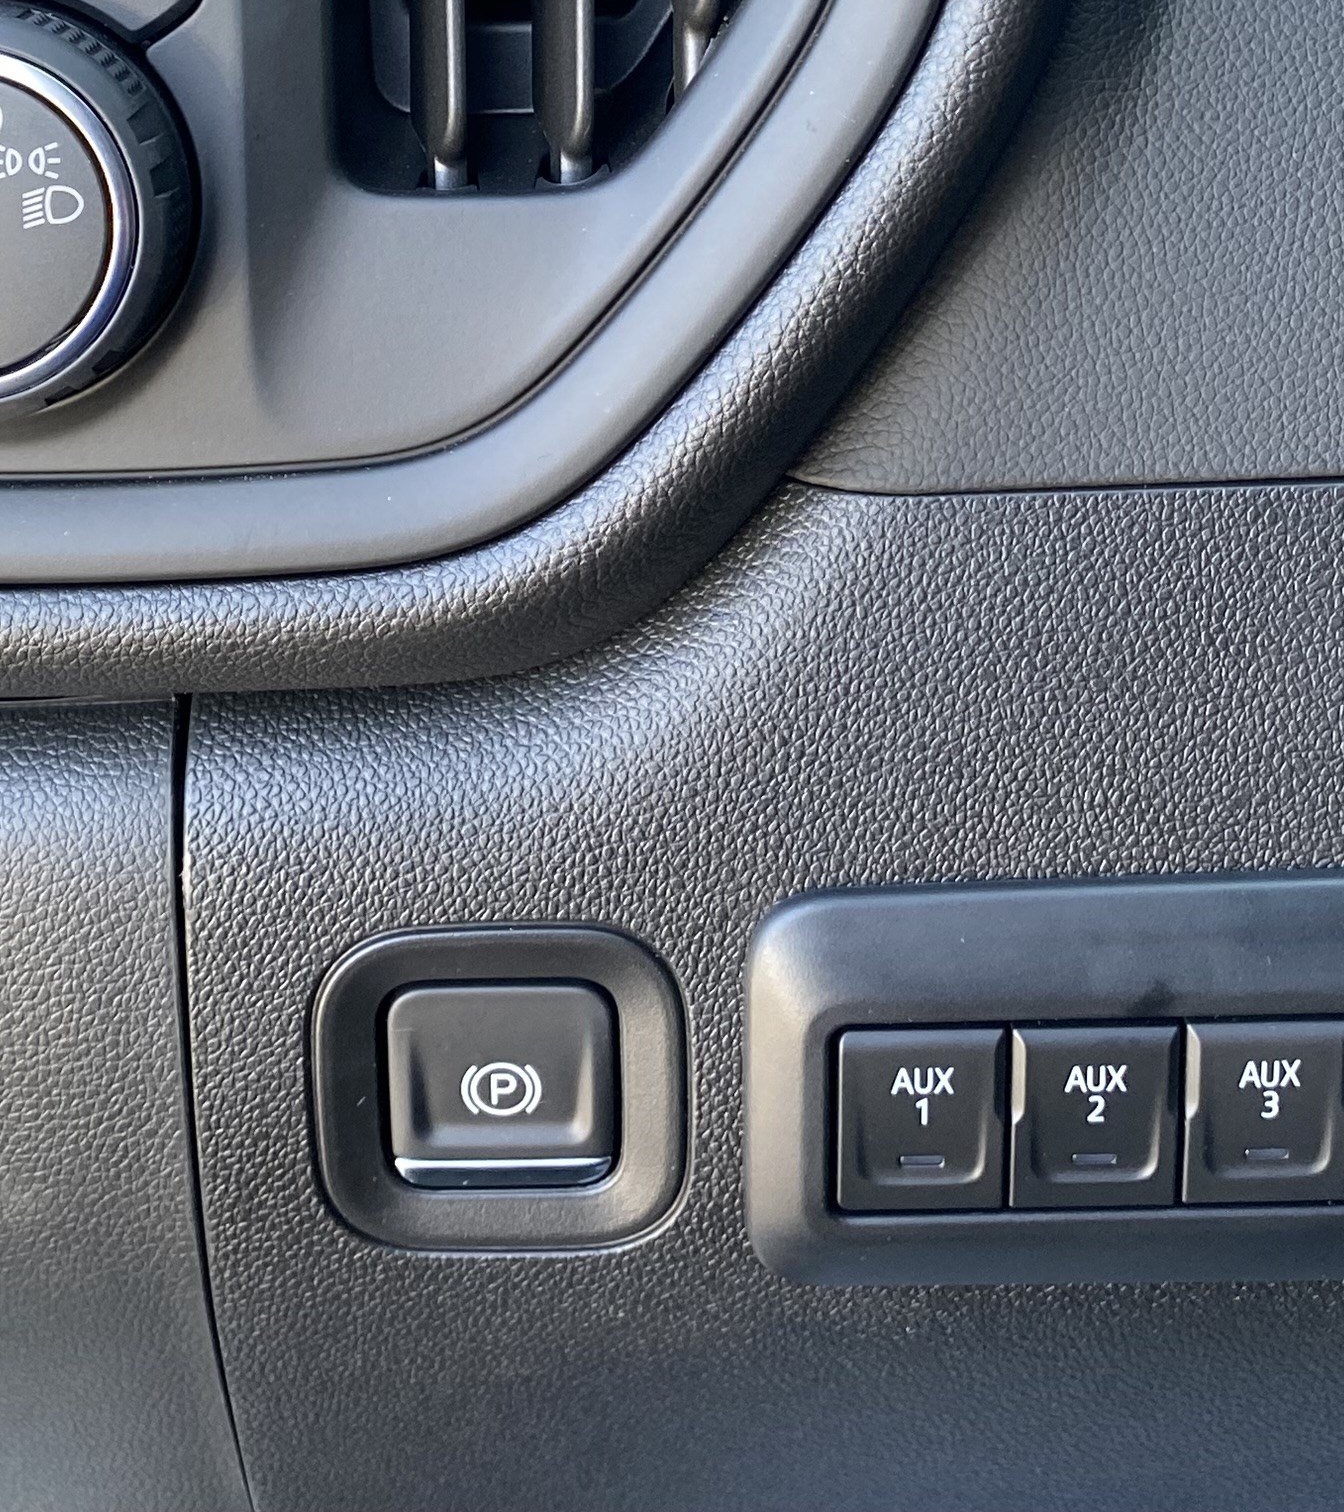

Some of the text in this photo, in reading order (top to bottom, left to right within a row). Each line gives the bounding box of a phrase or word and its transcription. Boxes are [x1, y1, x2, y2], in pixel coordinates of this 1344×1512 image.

[890, 1066, 955, 1096] AUX
[1064, 1064, 1128, 1094] AUX
[1238, 1058, 1302, 1089] AUX
[915, 1097, 929, 1126] 1
[1086, 1094, 1106, 1123] 2
[1260, 1090, 1280, 1119] 3
